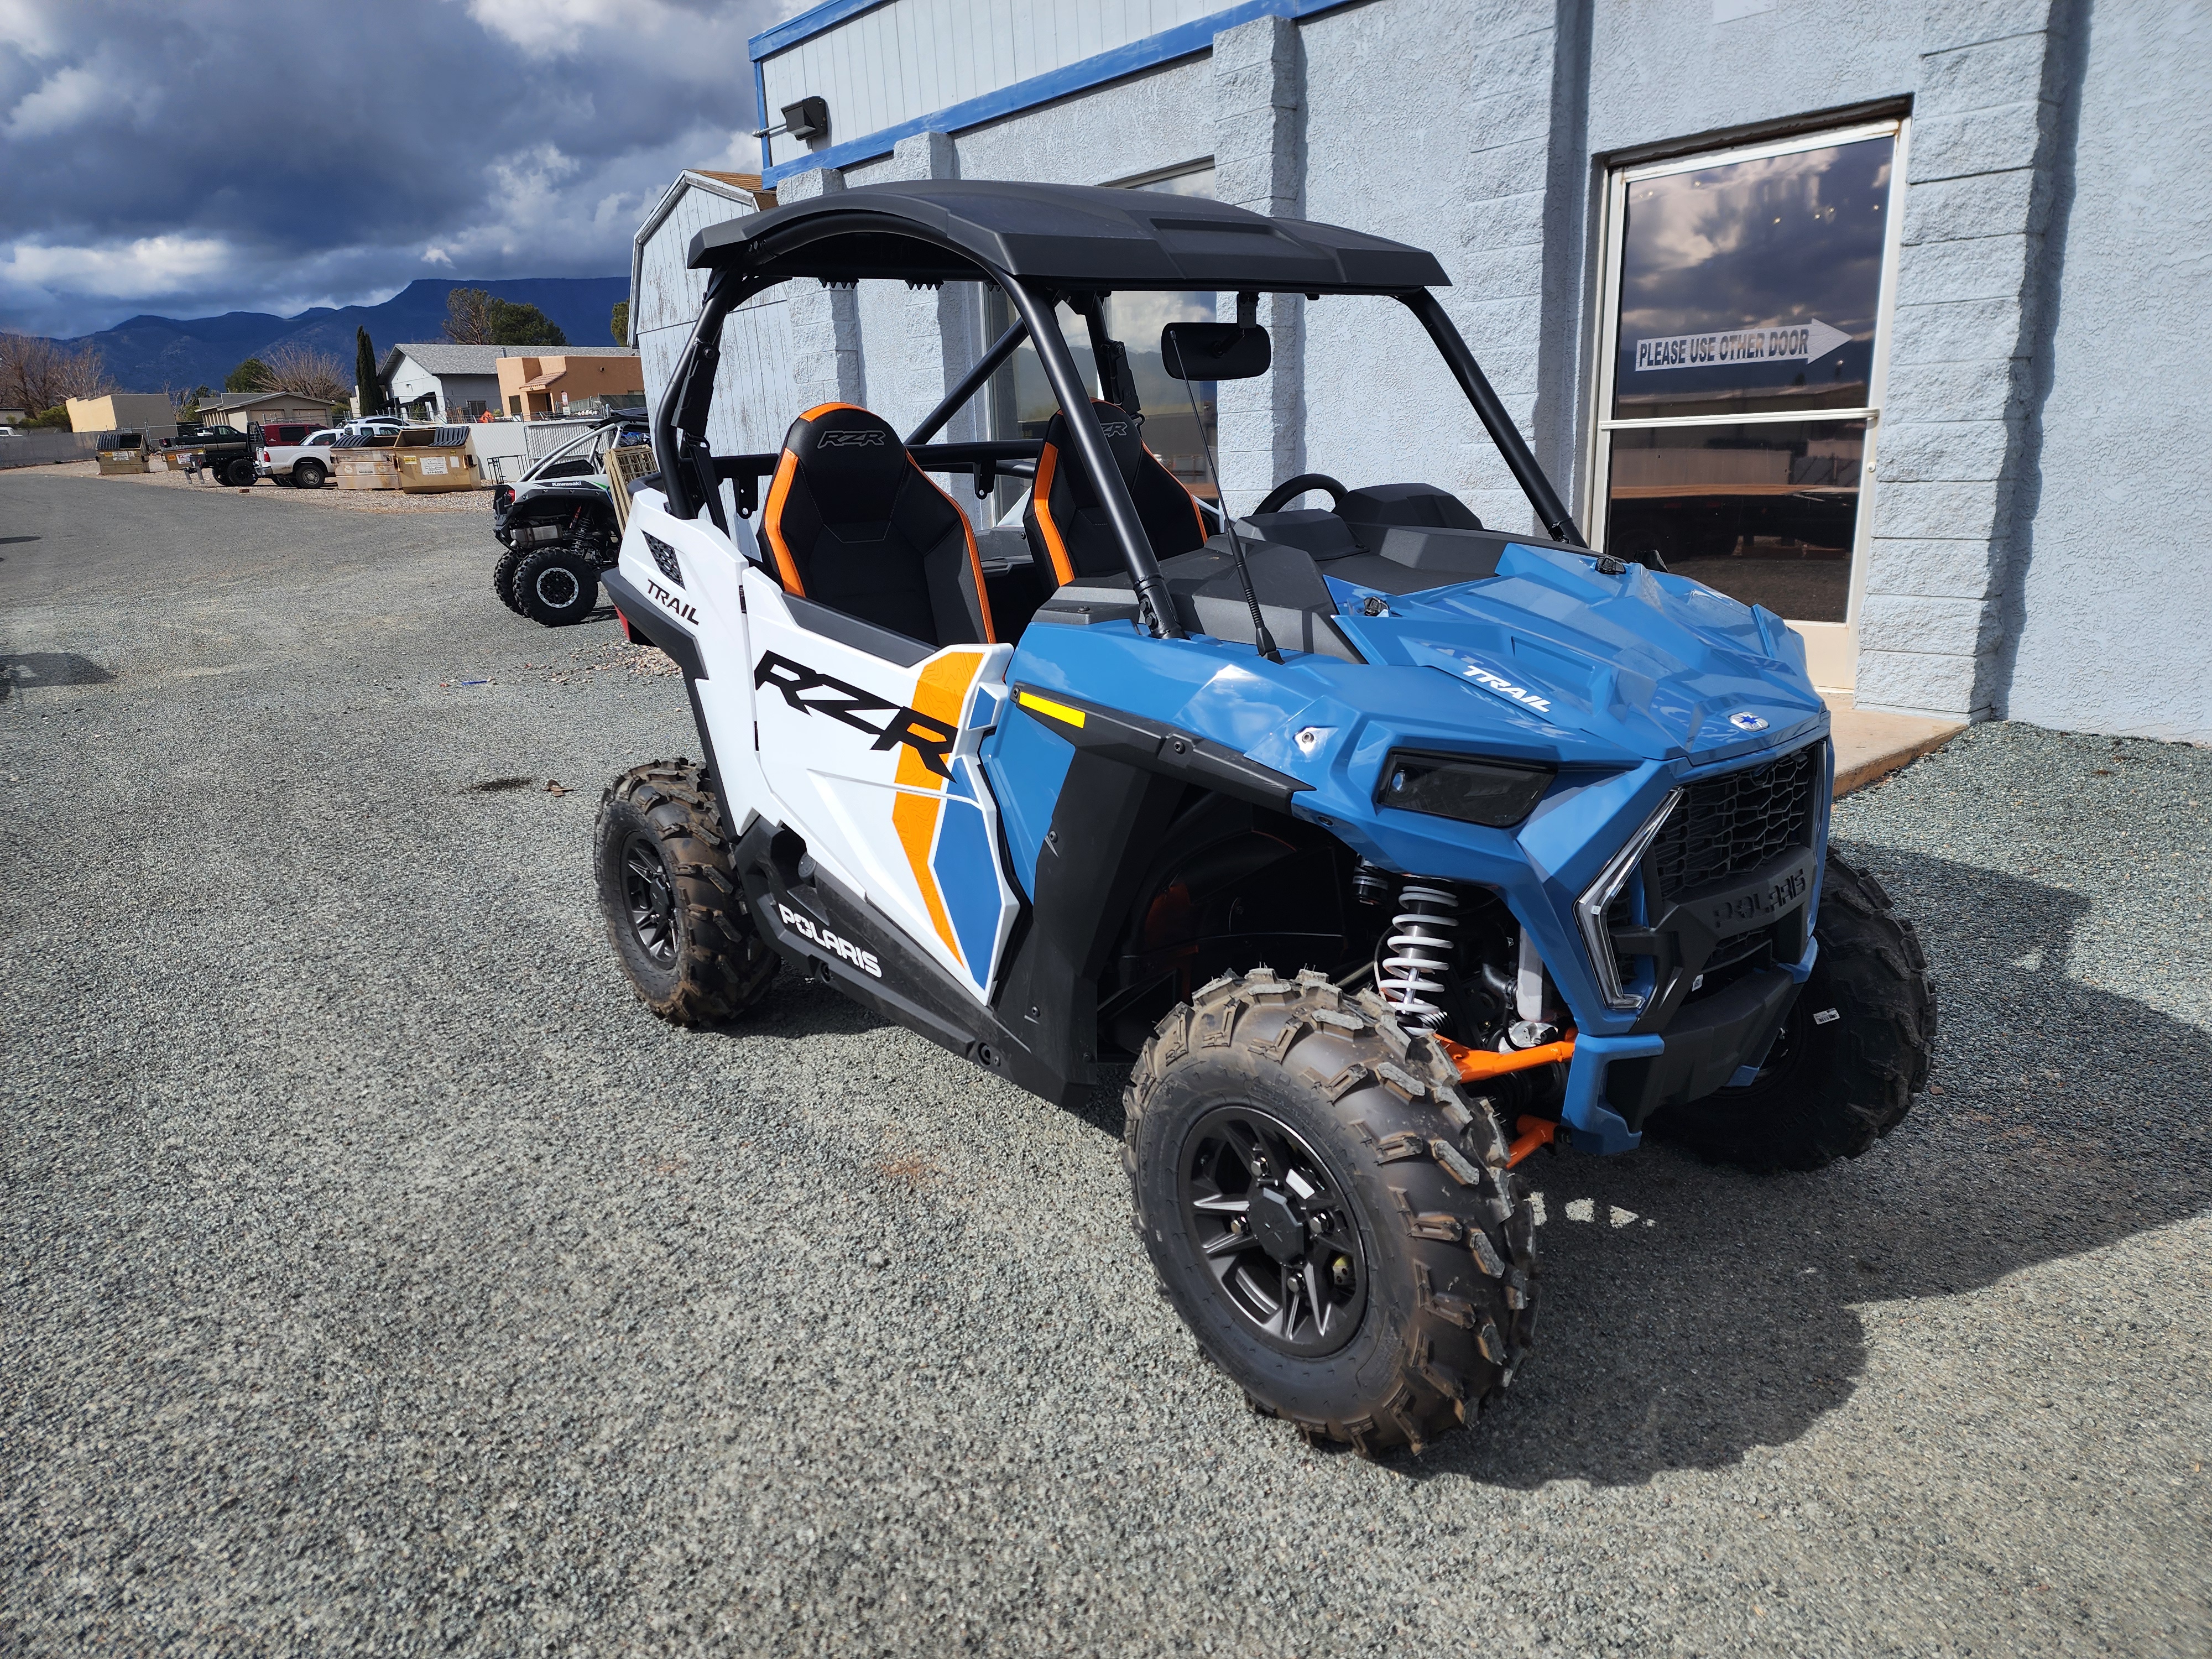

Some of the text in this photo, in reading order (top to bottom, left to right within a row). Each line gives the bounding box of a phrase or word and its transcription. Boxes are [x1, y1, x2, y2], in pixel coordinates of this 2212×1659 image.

[1639, 328, 1809, 367] PLEASE USE OTHER DOOR
[817, 430, 885, 448] RZR
[648, 578, 699, 625] TRAIL
[1463, 665, 1551, 713] TRAIL
[754, 650, 957, 783] RZR
[1713, 868, 1806, 928] POLARIS
[778, 904, 882, 978] POLARIS
